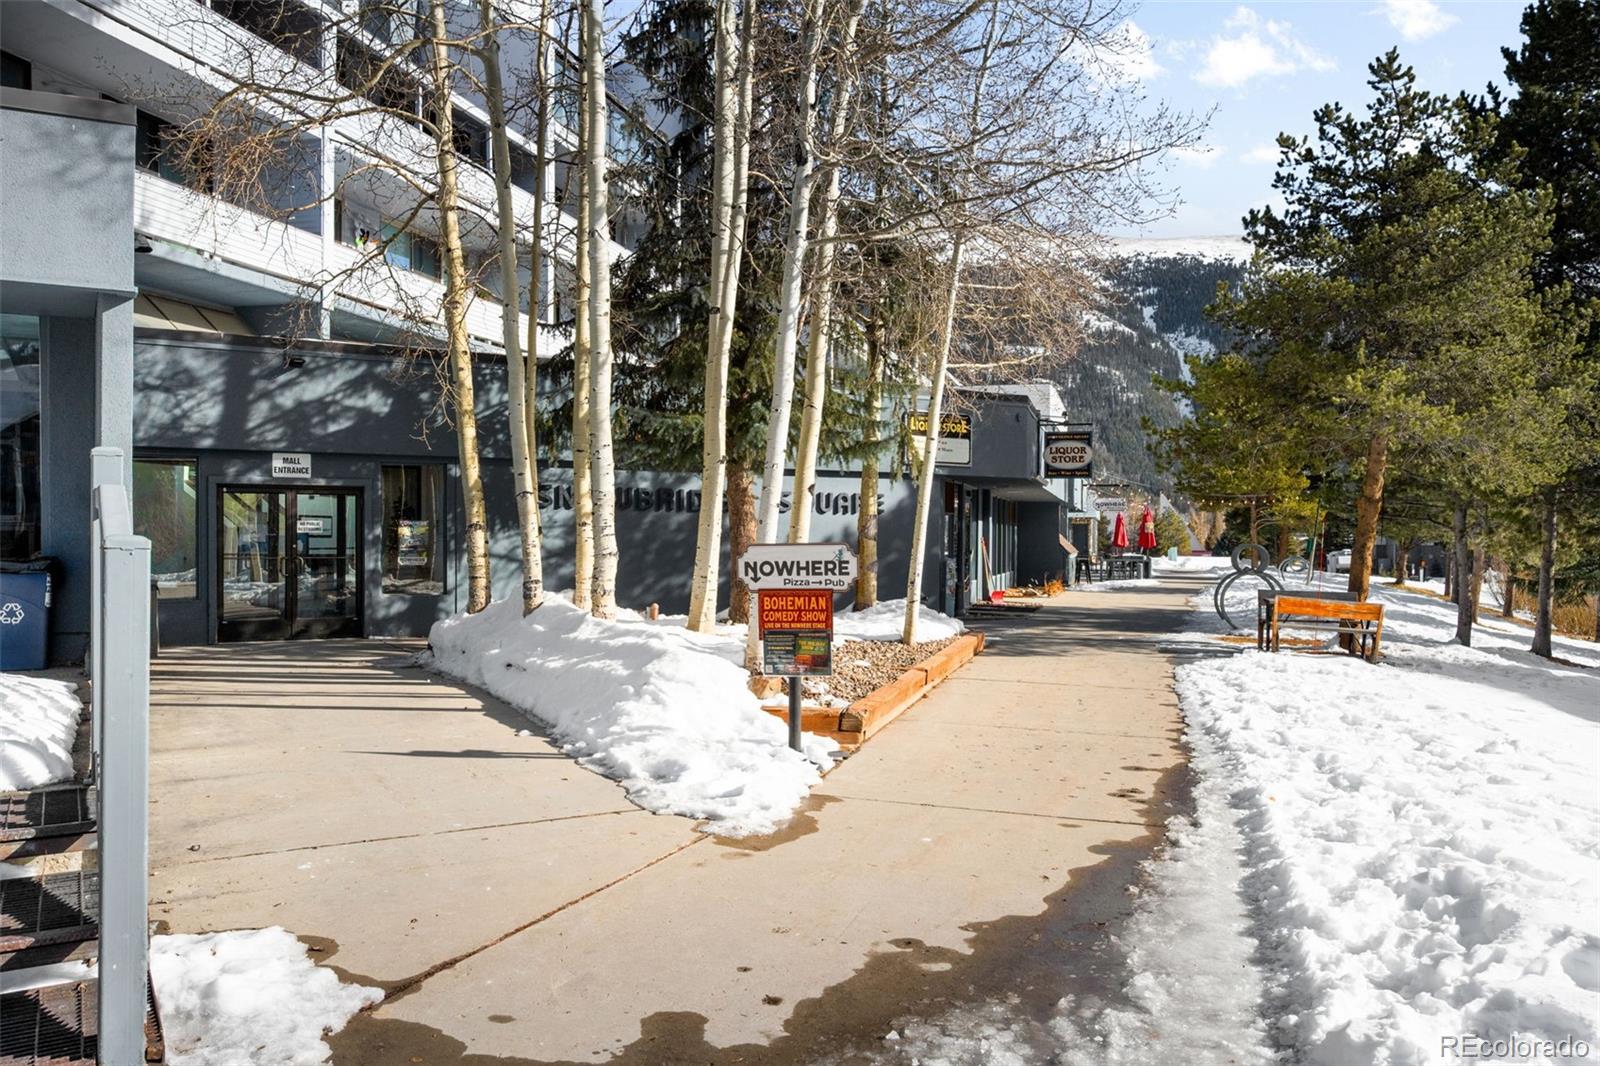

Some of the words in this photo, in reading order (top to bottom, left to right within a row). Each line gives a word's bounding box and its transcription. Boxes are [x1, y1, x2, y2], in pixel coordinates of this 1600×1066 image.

[1049, 446, 1087, 455] LIQUOR
[282, 457, 301, 465] MALL
[1051, 456, 1085, 464] STORE
[273, 466, 310, 474] ENTRANCE
[744, 560, 850, 578] NOWHERE
[783, 578, 811, 587] Pizza
[824, 578, 845, 587] Pub
[763, 596, 827, 610] BOHEMIAN
[763, 611, 800, 621] COMEDY
[801, 611, 827, 621] SHOW
